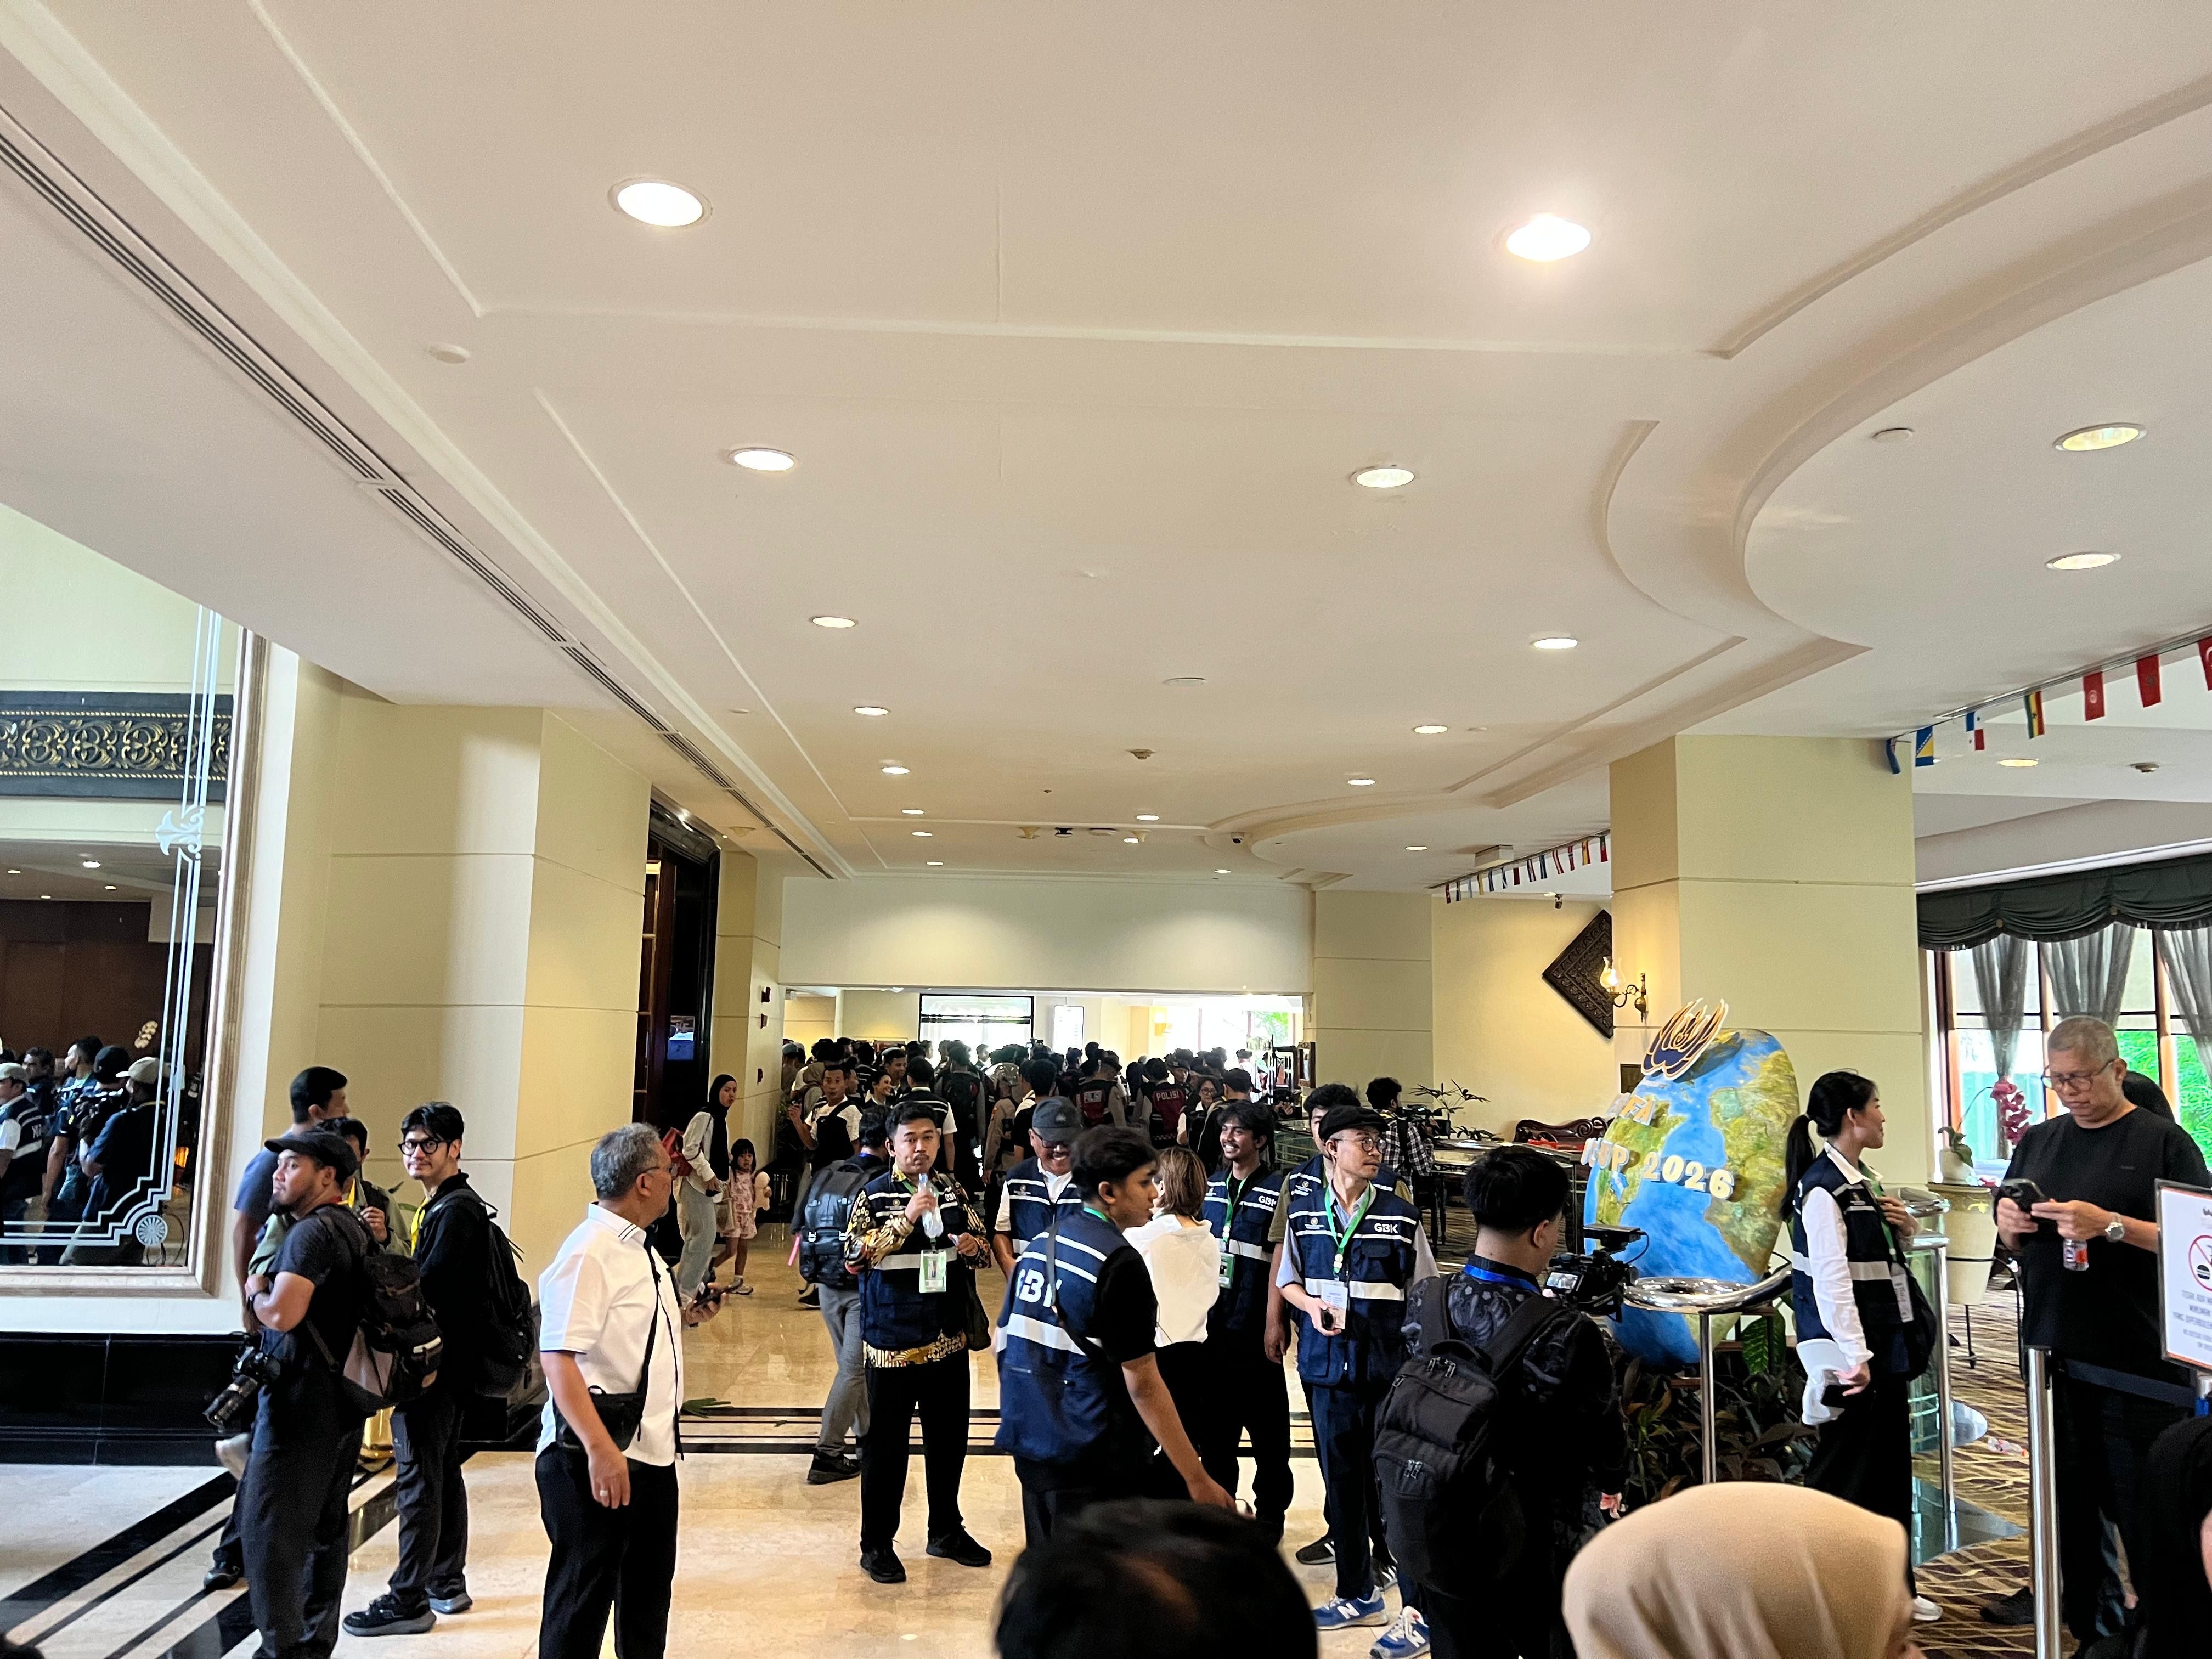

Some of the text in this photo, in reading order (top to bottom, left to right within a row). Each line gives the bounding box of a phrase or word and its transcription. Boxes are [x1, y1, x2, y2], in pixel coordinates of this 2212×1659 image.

[1156, 1091, 1180, 1101] POLISI
[1643, 1151, 1734, 1200] 2026
[1374, 1223, 1398, 1234] GBK
